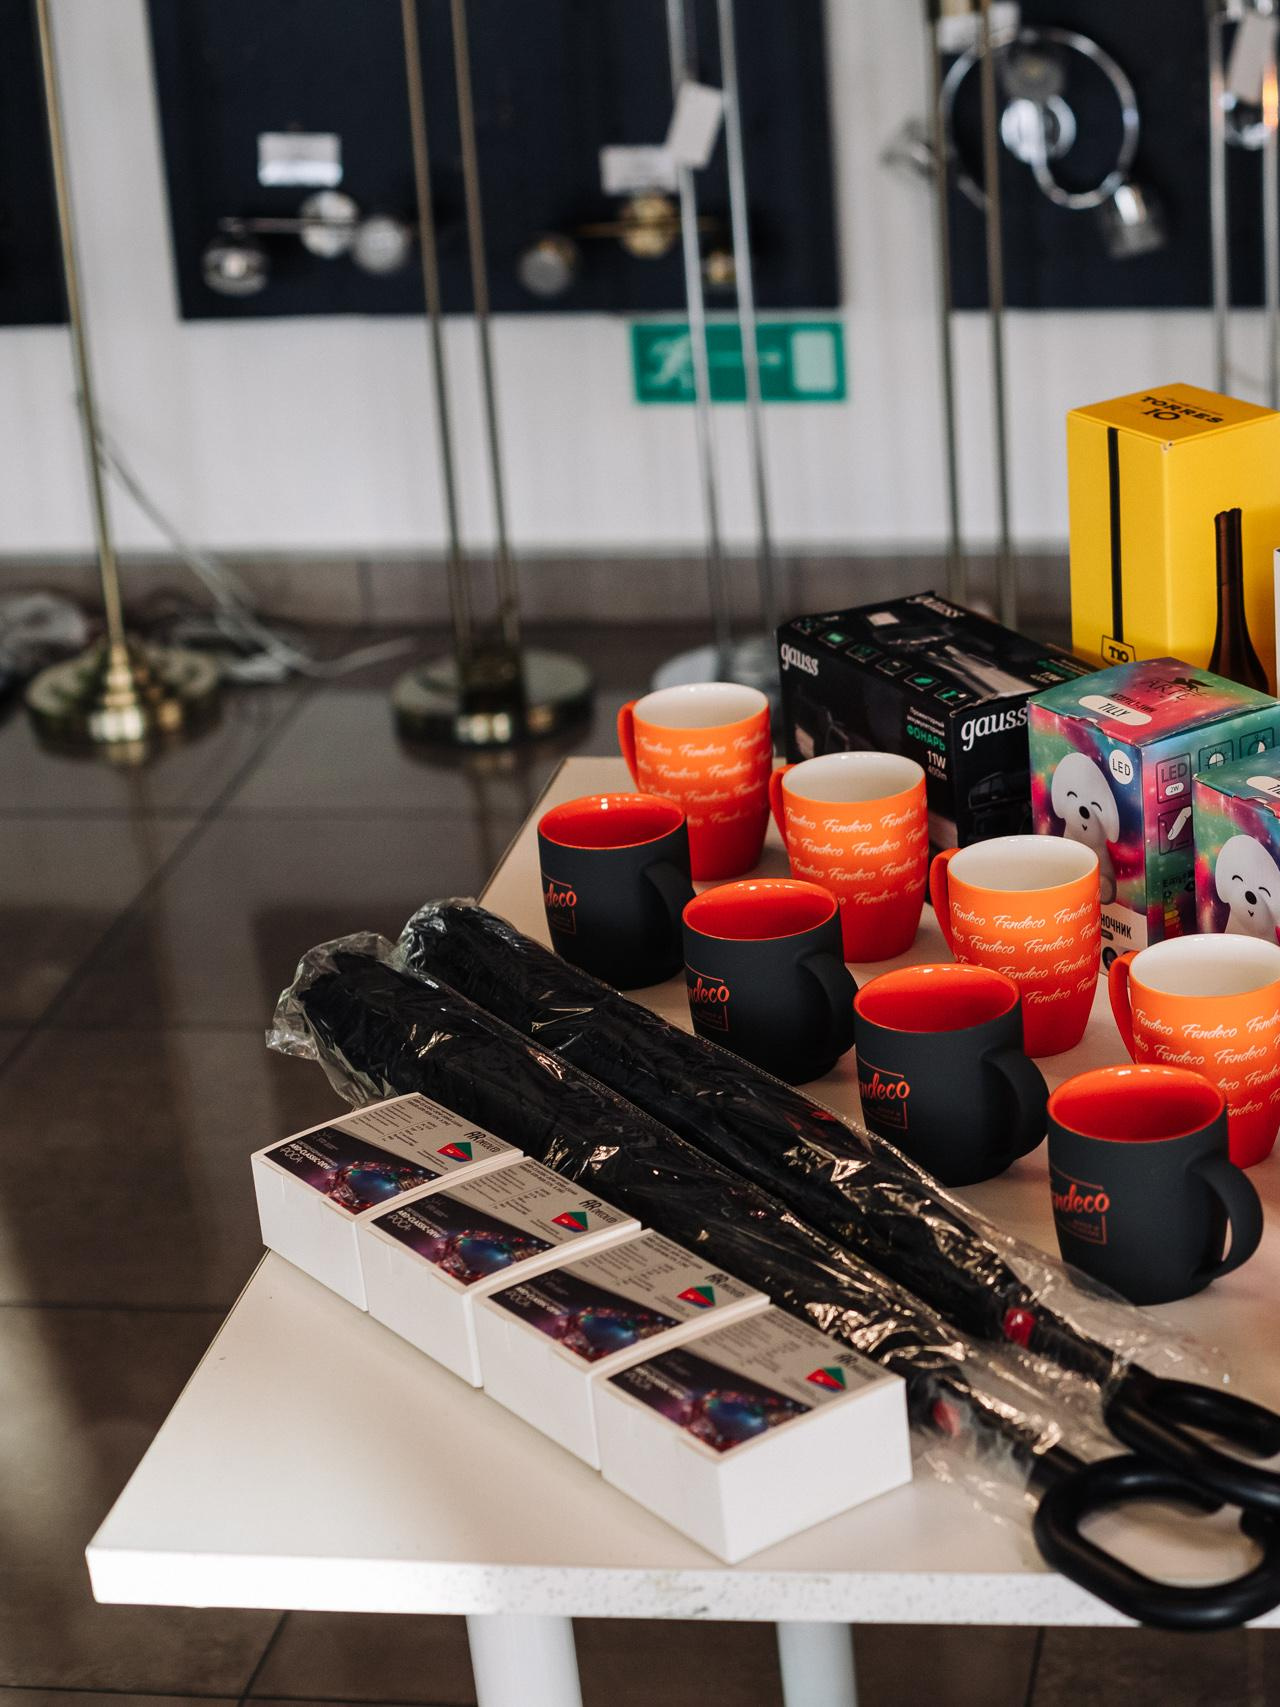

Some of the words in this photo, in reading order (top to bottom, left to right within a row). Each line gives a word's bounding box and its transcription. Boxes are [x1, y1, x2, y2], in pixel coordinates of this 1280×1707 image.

[1141, 395, 1224, 424] TORRES
[1143, 408, 1181, 421] 10
[780, 643, 820, 677] gauss
[1108, 646, 1129, 663] T10
[1096, 702, 1132, 718] TILLY
[906, 724, 946, 751] ФОНАРЬ
[960, 705, 1028, 751] gauss
[926, 750, 947, 770] 11W
[1111, 758, 1131, 778] LED
[1160, 760, 1188, 783] LED
[1169, 784, 1180, 795] 2W
[822, 818, 872, 834] Fandeco
[800, 838, 844, 857] Fandeco
[851, 839, 900, 856] Fandeco
[828, 866, 876, 881] Fandeco
[952, 901, 986, 927] Fandeco
[992, 914, 1046, 930] Fandeco
[1053, 902, 1093, 925] Fandeco
[968, 934, 1016, 955] Fandeco
[1023, 936, 1075, 954] Fandeco
[998, 965, 1049, 981] Fandeco
[1053, 953, 1092, 976] Fandeco
[687, 977, 730, 1003] ndeco
[1025, 988, 1072, 1005] Fandeco
[1136, 1007, 1174, 1036] Fandeco
[1181, 1022, 1238, 1040] Fandeco
[1154, 1043, 1206, 1066] Fandeco
[1214, 1044, 1268, 1065] Fandeco
[860, 1072, 911, 1101] ndeco
[1226, 1100, 1264, 1118] andeco
